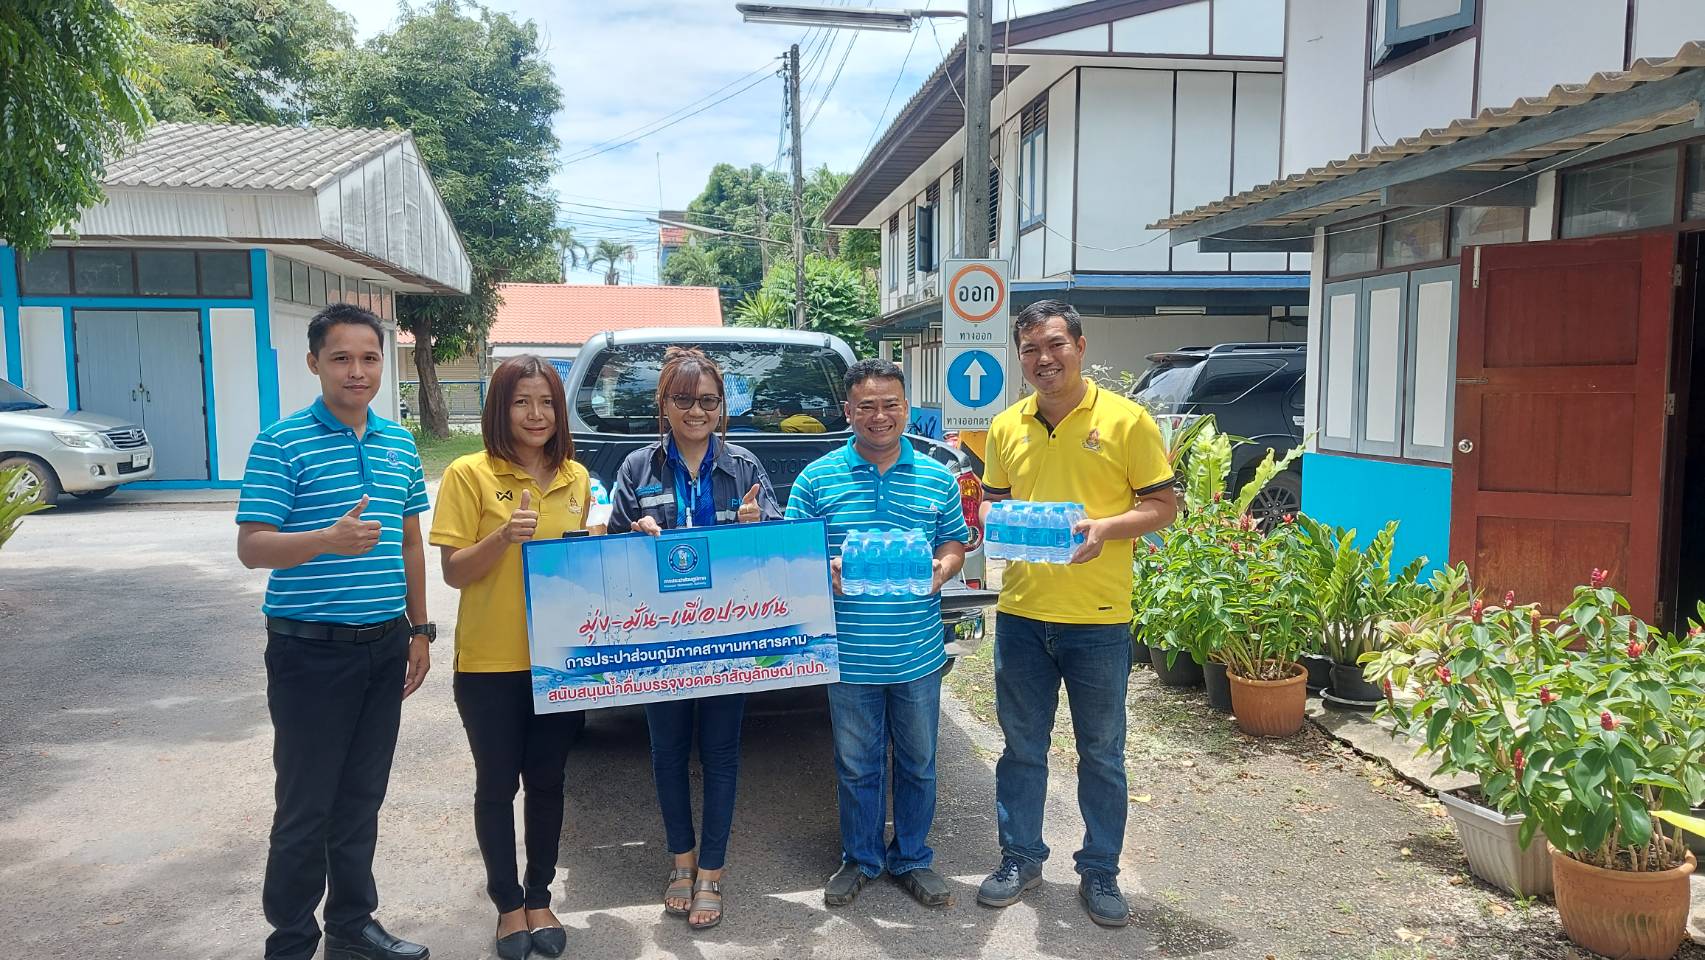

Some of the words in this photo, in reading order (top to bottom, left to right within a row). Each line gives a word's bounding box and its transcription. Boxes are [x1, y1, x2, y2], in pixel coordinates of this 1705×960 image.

[959, 286, 994, 302] ออก
[960, 331, 992, 341] ทางออก
[578, 596, 788, 643] มุ่ง-มั่น-เพื่อปวงชน
[565, 633, 807, 669] การประปาส่วนภูมิภาคสาขามหาสารคาม
[548, 664, 793, 702] สนับสนุนน้ำดื่มบรรจุขวดตราสัญลักษณ์
[796, 661, 829, 676] กปภ.
